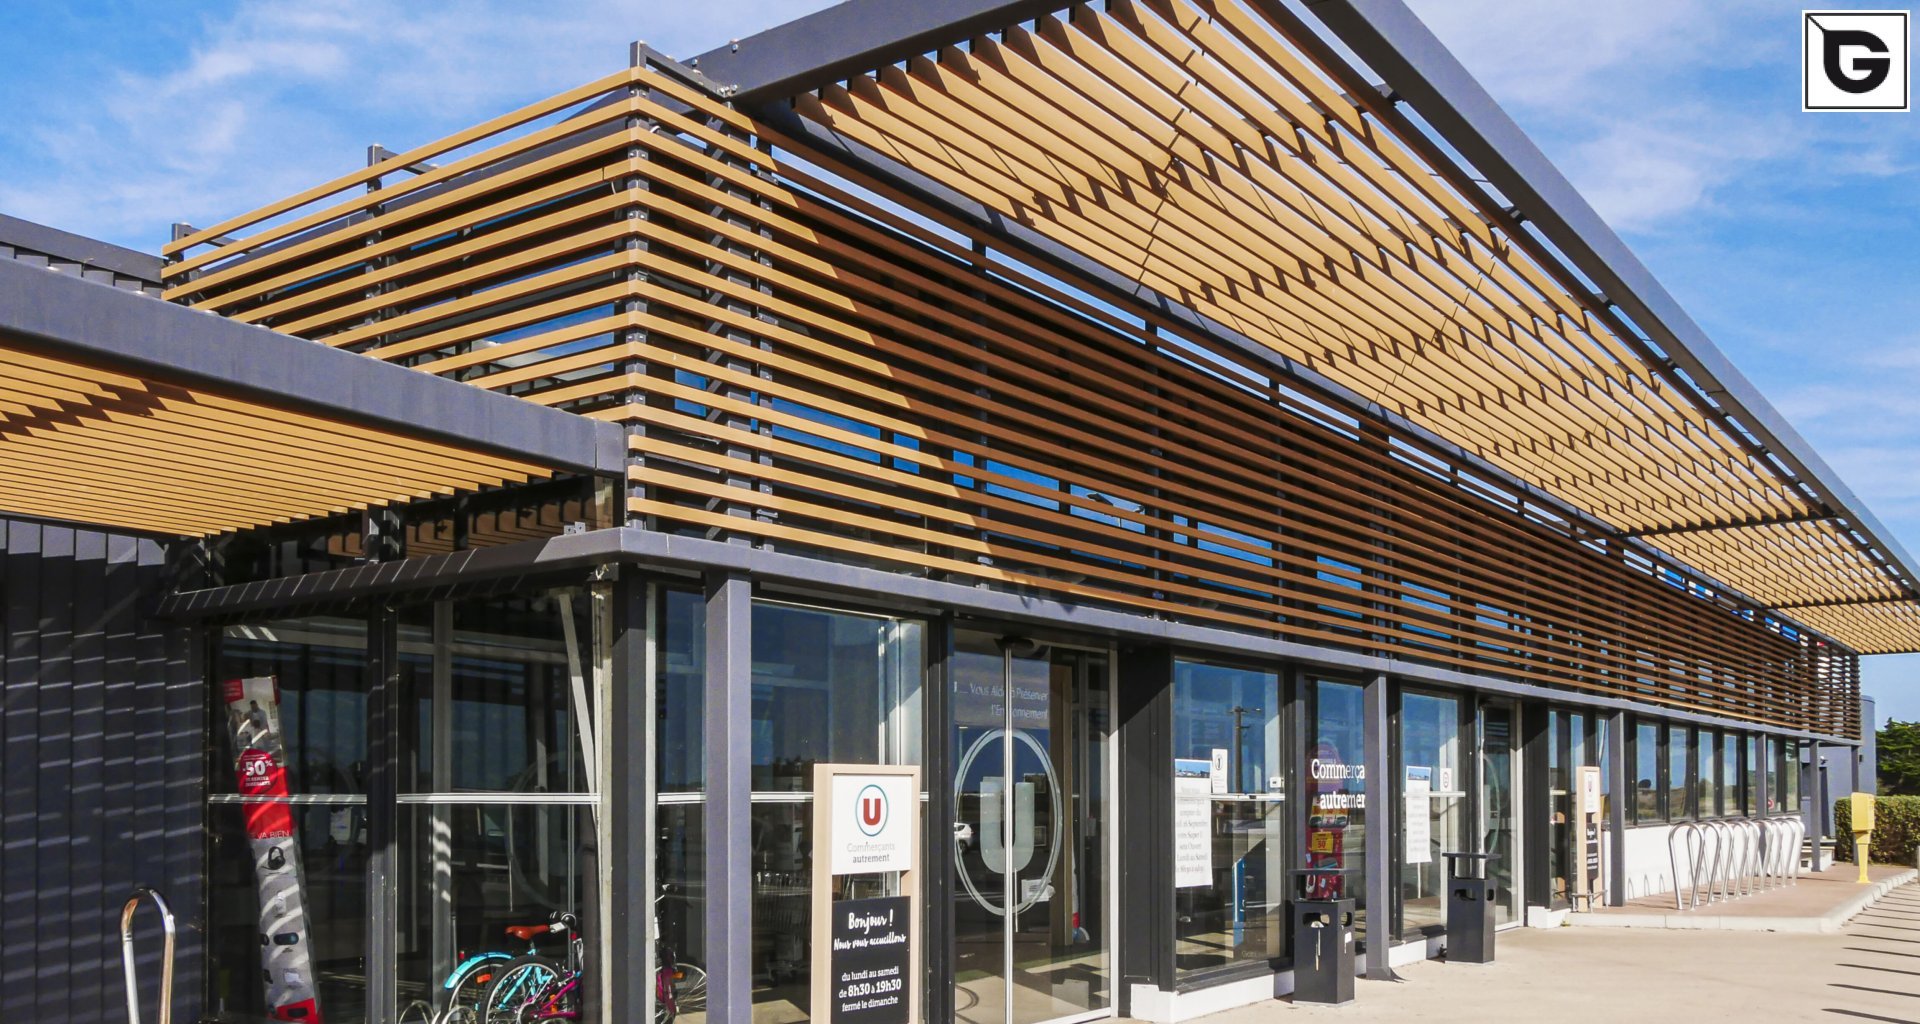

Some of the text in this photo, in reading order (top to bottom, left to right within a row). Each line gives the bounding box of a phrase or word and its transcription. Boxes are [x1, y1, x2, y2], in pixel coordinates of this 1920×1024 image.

[991, 684, 1005, 697] Aid
[863, 798, 881, 826] U
[980, 781, 1034, 874] U
[846, 841, 895, 853] Commerçants
[852, 854, 890, 863] autrement
[848, 912, 887, 935] Bonjour
[834, 932, 906, 951] Nous vous accueillons
[842, 966, 899, 981] du lundi au samedi
[839, 990, 847, 999] de
[848, 983, 870, 997] 8h30
[876, 978, 902, 993] 19h30
[842, 996, 898, 1012] fermé le dimanche
